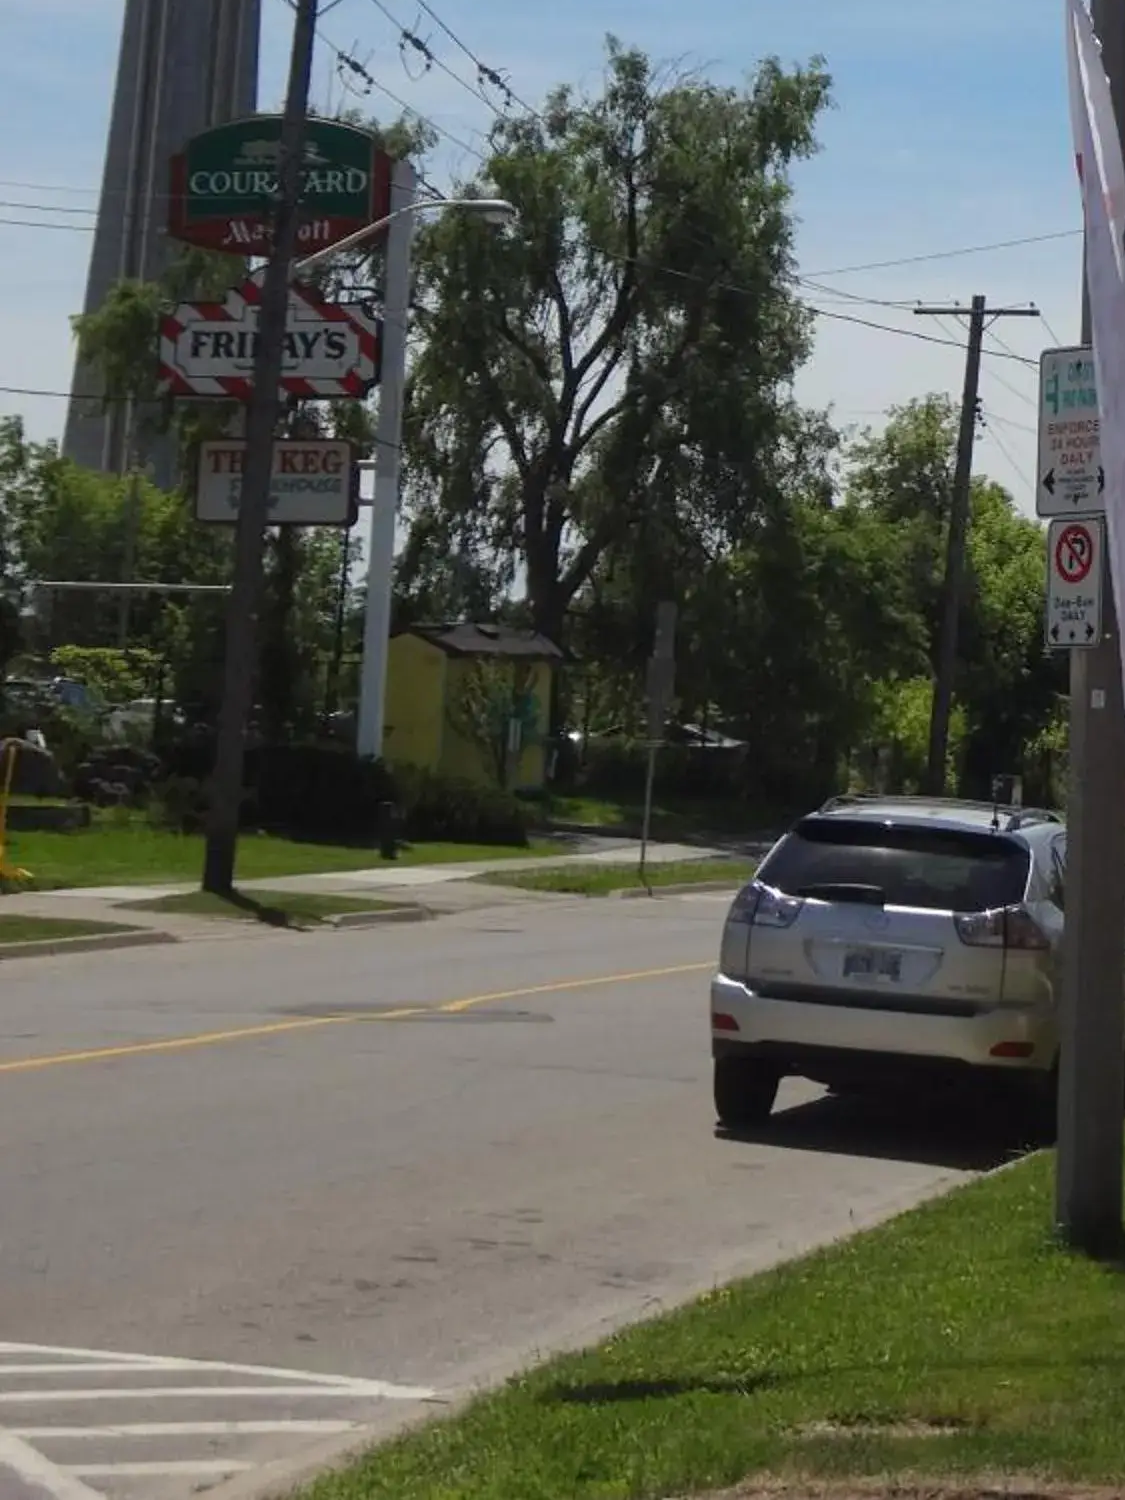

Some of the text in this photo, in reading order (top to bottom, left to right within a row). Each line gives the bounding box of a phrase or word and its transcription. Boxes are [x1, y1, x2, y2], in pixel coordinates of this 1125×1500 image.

[190, 167, 367, 194] COURARD
[190, 328, 347, 360] FRIAY'S
[207, 449, 344, 474] TH KEG
